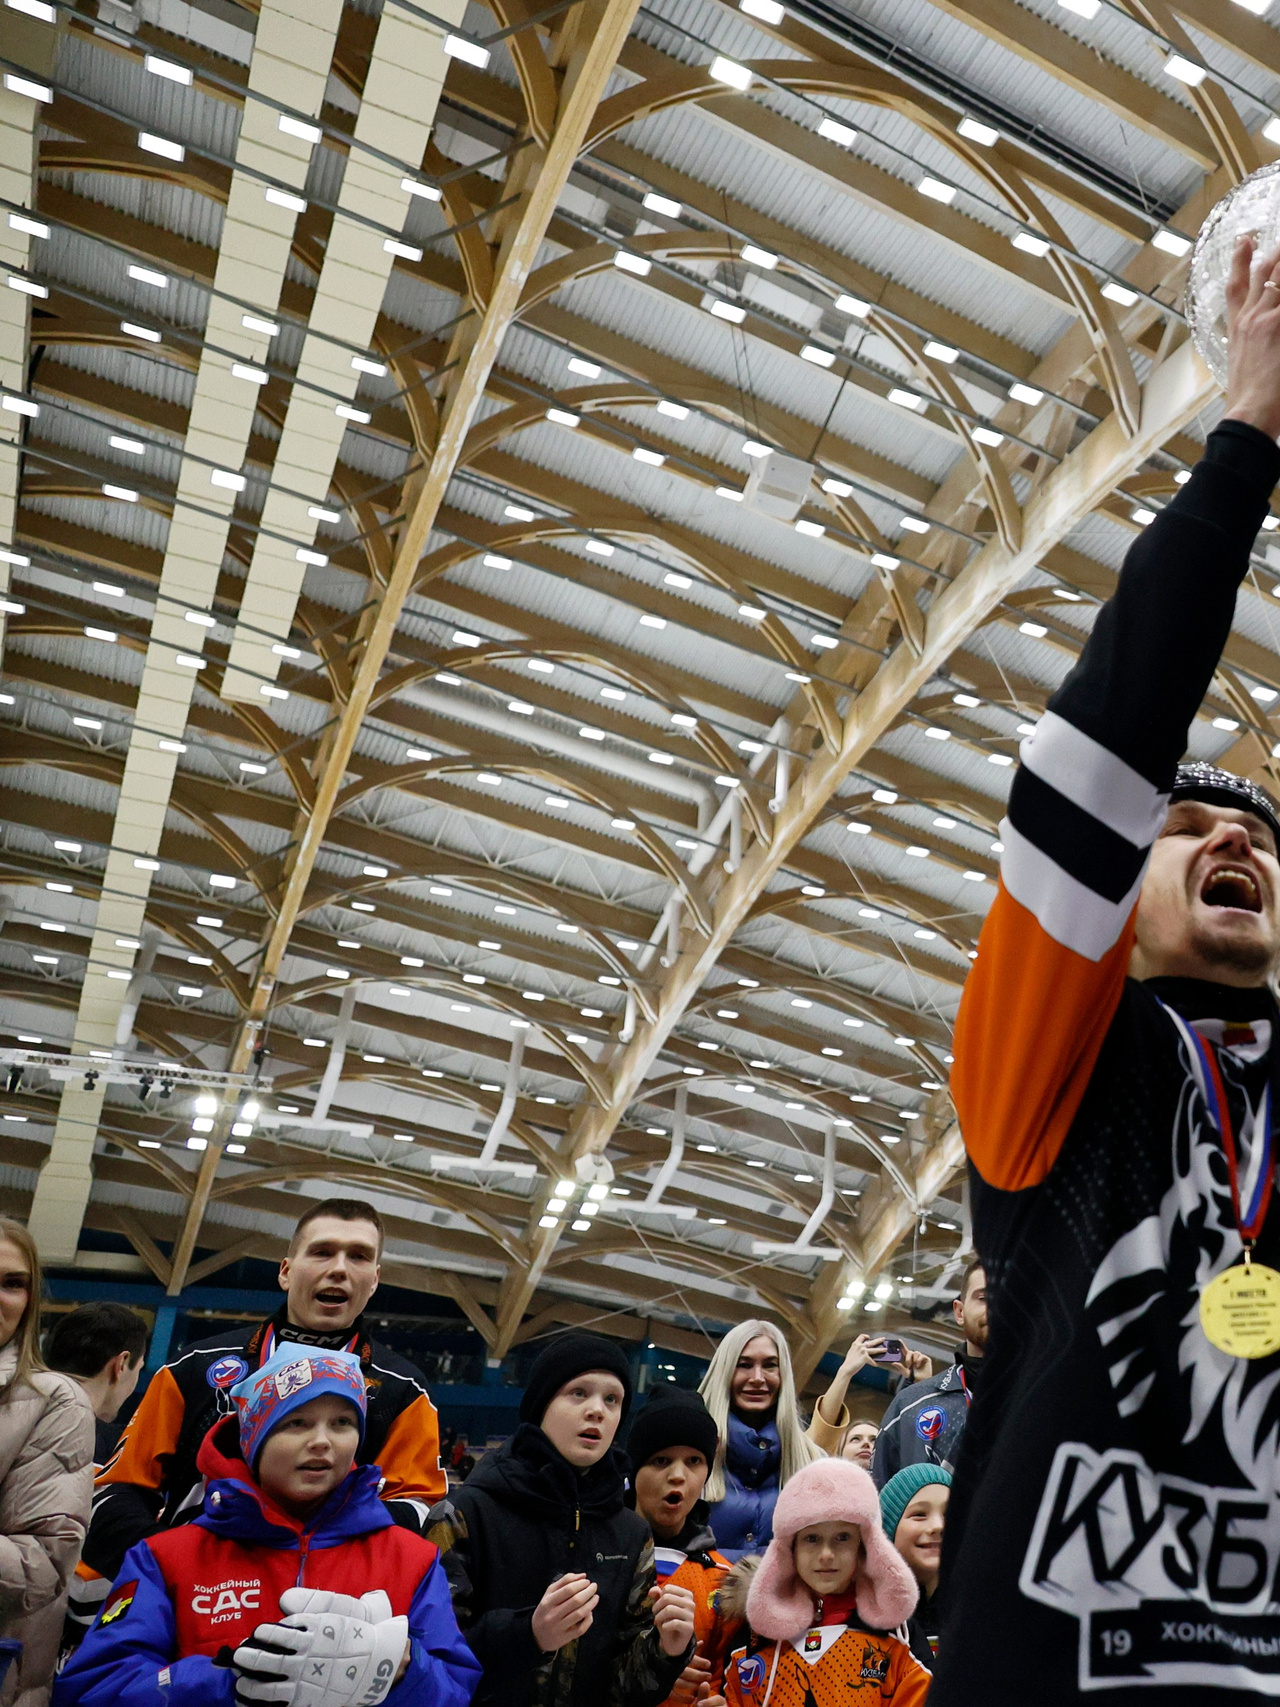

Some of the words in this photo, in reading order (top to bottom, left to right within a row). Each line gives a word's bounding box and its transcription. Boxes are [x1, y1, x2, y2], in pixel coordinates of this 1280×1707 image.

[280, 1328, 344, 1345] CCM
[193, 1579, 261, 1594] ХОККЕЙНЫЙ
[191, 1589, 260, 1615] СДС
[210, 1611, 242, 1625] КЛУБ
[1100, 1629, 1133, 1656] 19
